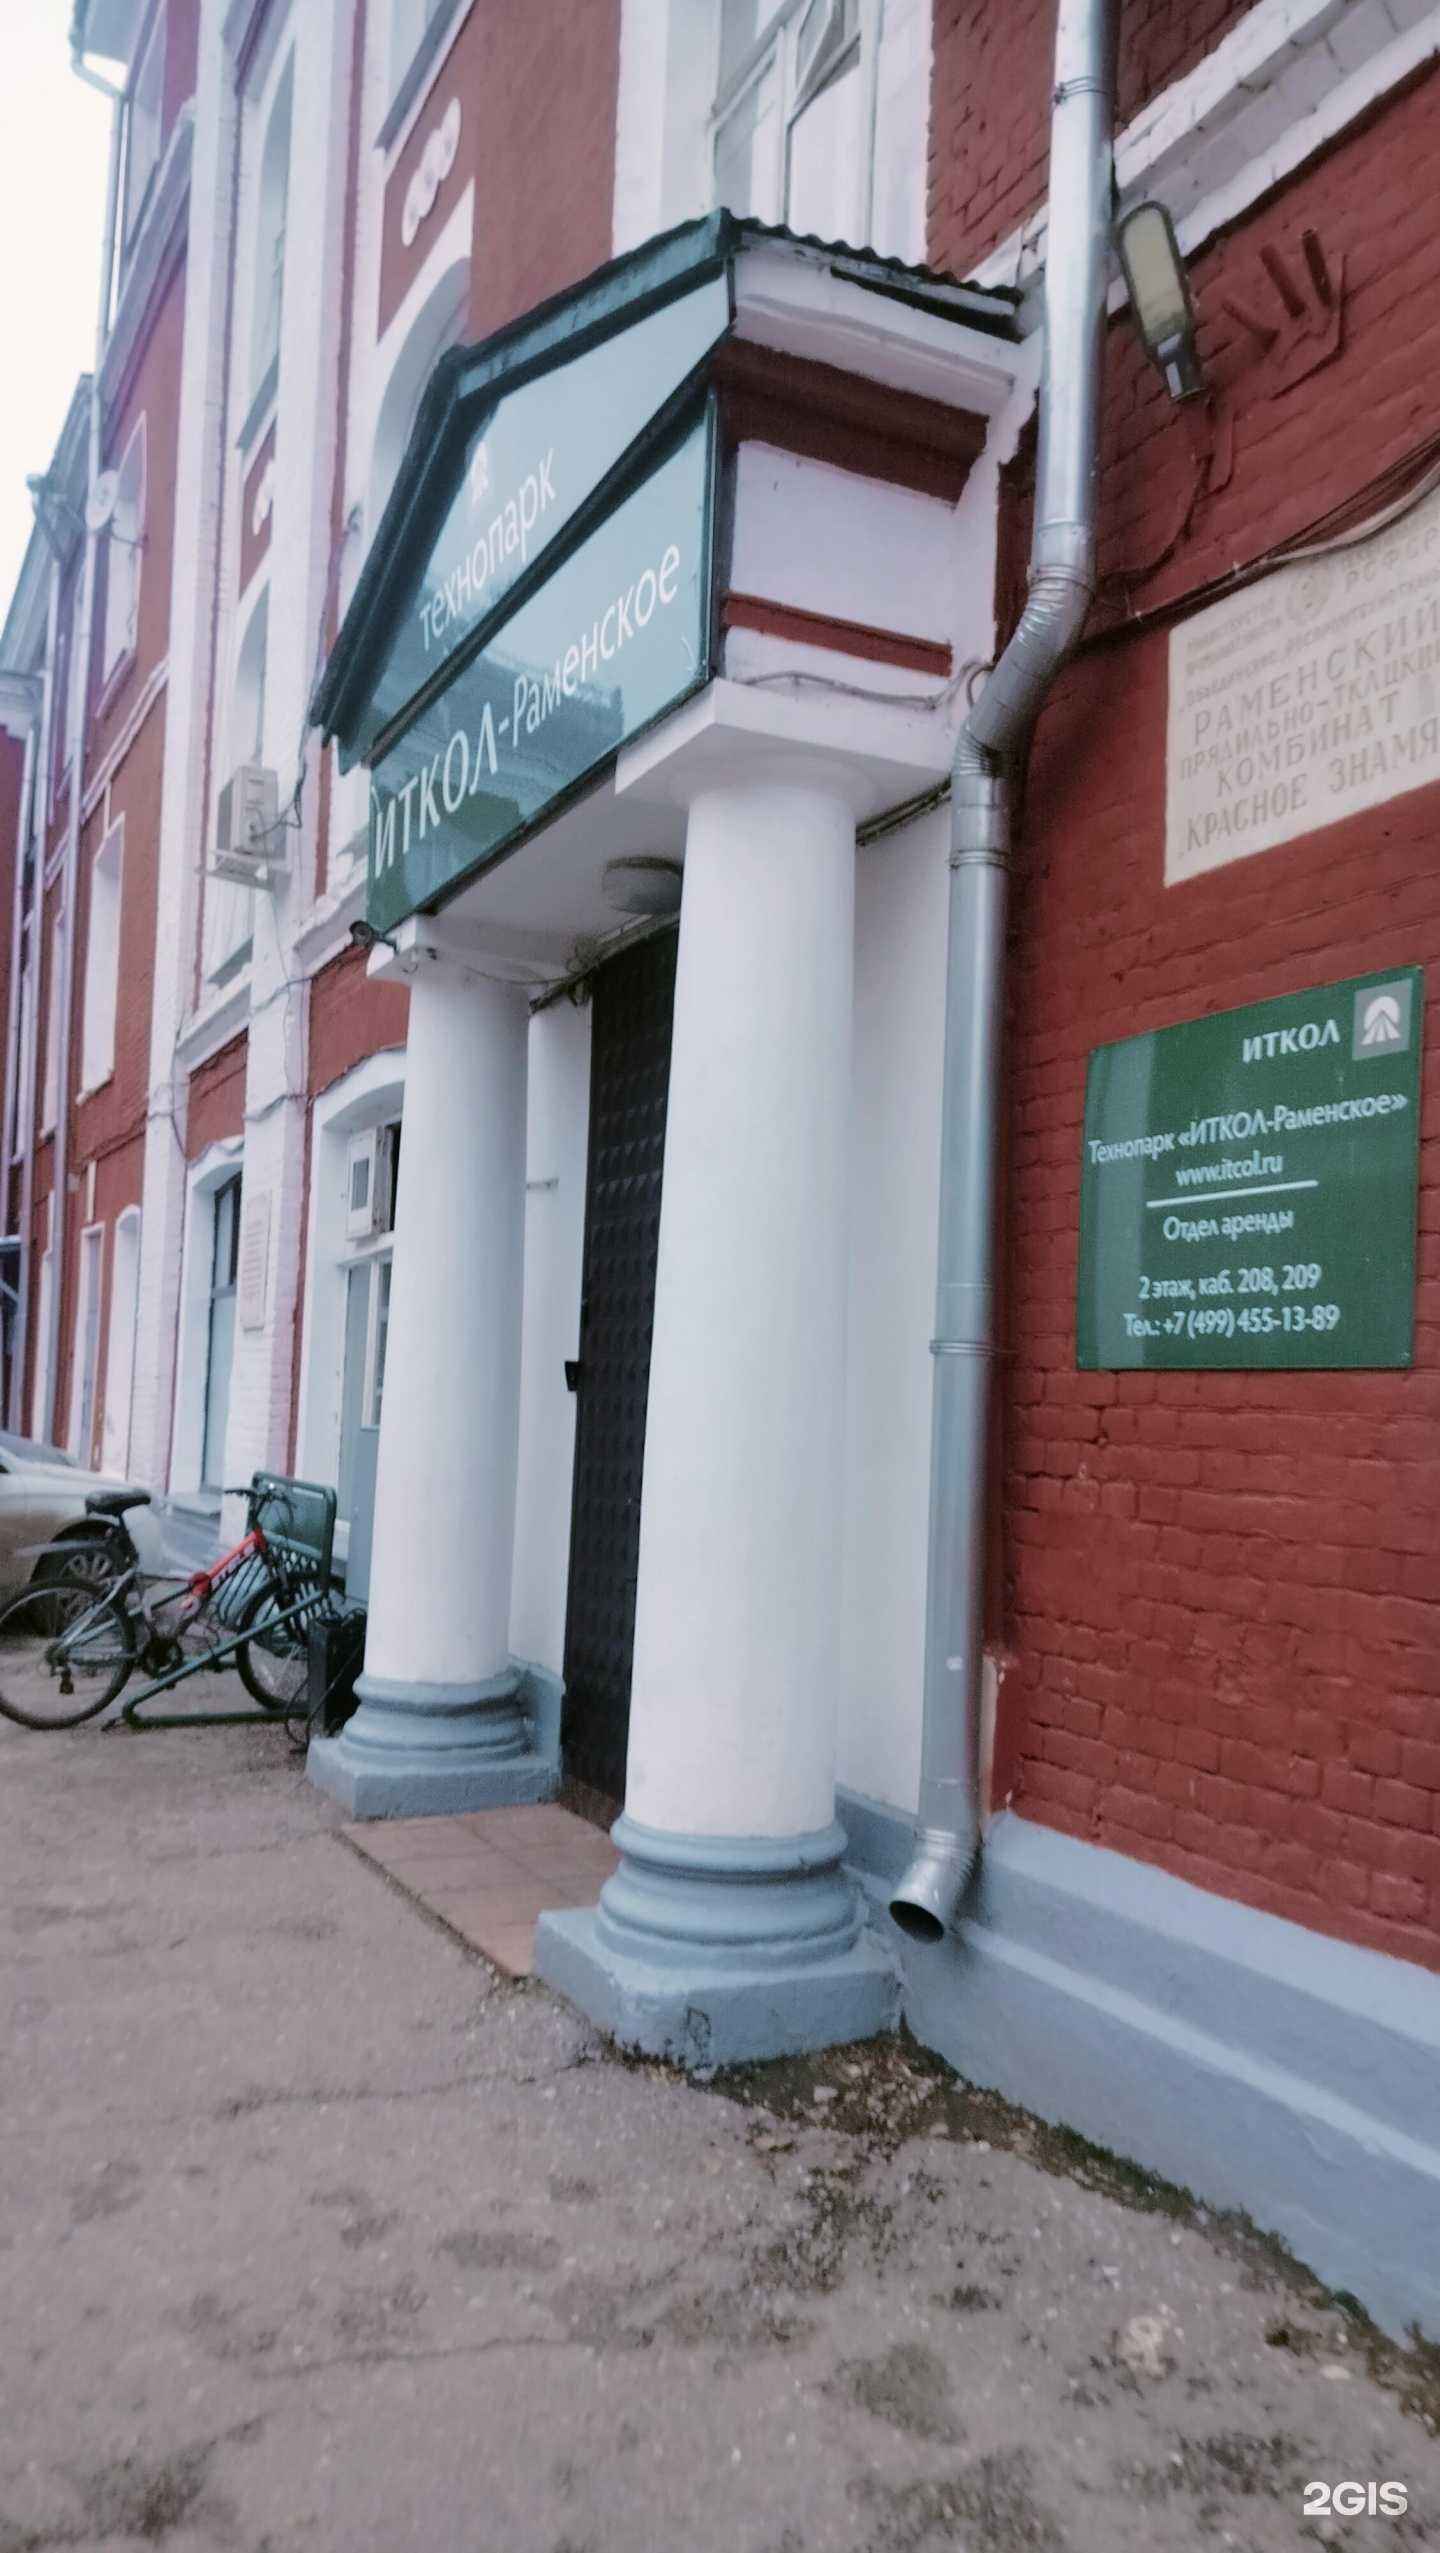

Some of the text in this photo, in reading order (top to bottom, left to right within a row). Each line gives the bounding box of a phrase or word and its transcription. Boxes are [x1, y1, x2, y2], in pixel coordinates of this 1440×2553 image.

[419, 448, 557, 651] технопарк
[1194, 593, 1439, 746] РАМЕНСКИЙ
[373, 544, 680, 879] ИТКОЛ-Раменское
[1216, 690, 1400, 798] КОМБИНАТ
[1242, 1019, 1341, 1064] ИТКОЛ
[1088, 1093, 1409, 1164] Технопарк «ИТКОЛ-Раменское»
[1175, 1149, 1284, 1186] www.itcol.ru
[1162, 1210, 1295, 1243] Отдел аренды
[1137, 1262, 1322, 1301] 2 этаж, каб. 208, 209
[1123, 1303, 1341, 1340] Тел.: +7 (499) 455-13-89
